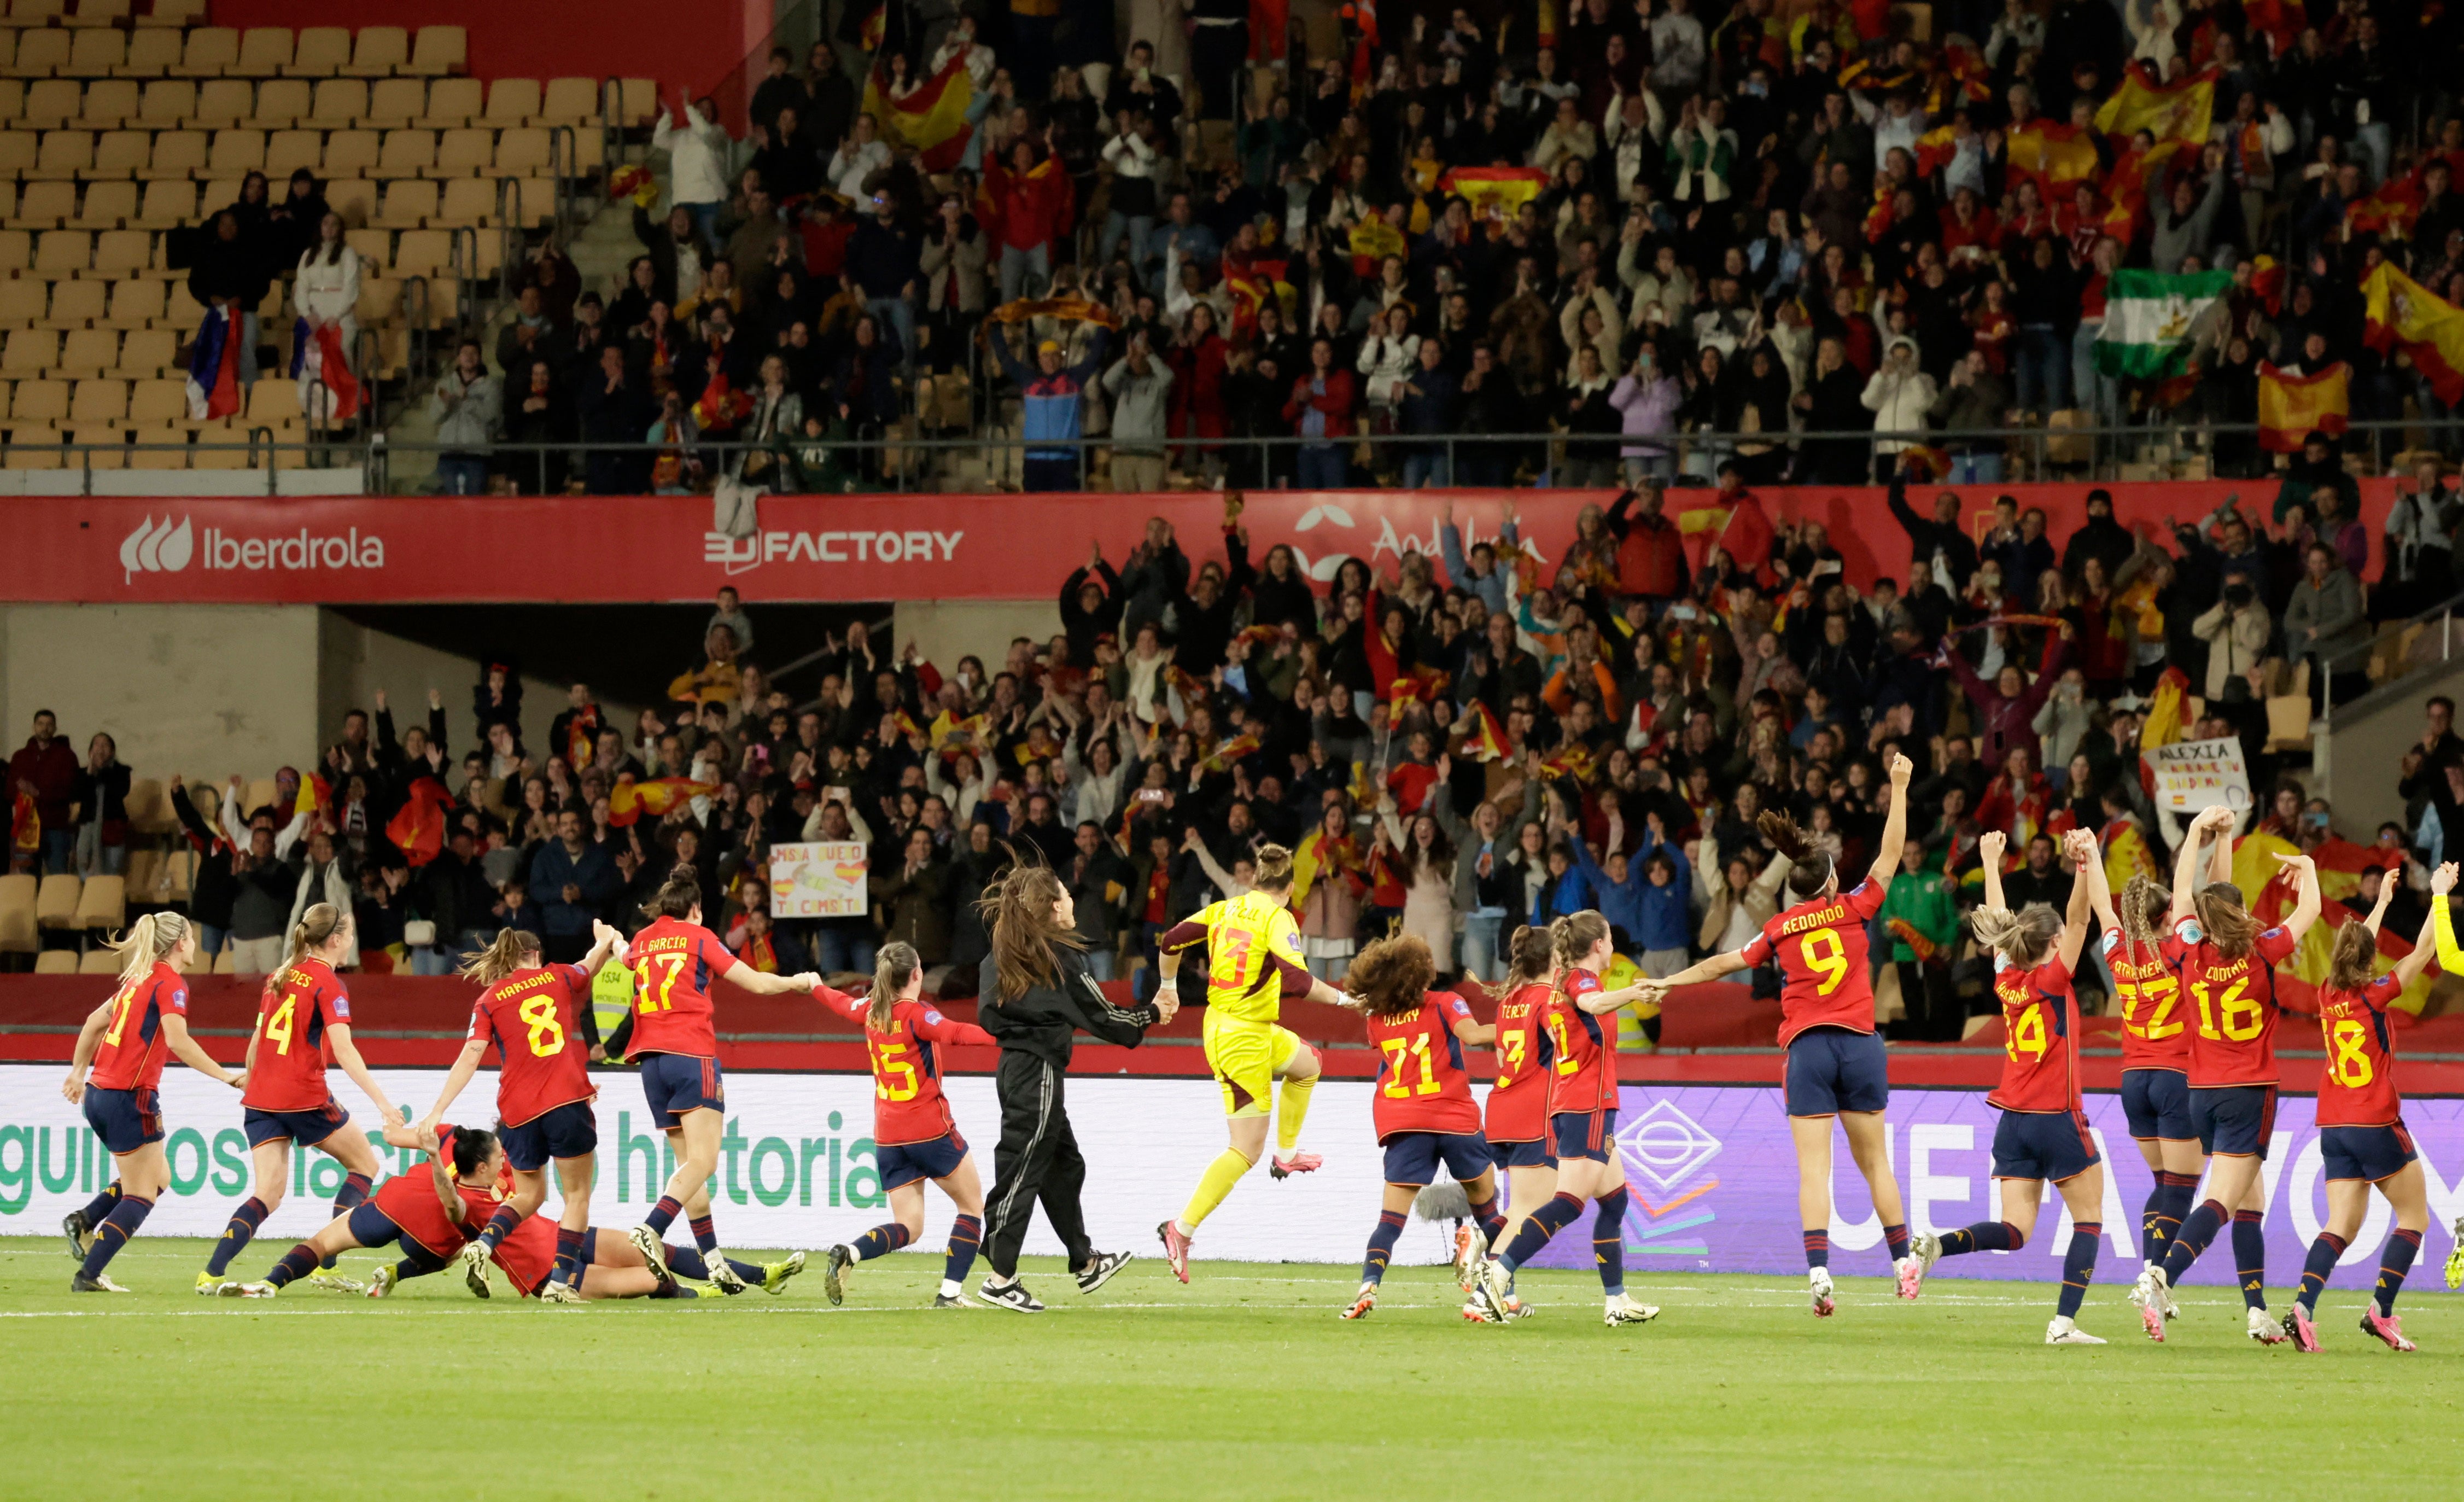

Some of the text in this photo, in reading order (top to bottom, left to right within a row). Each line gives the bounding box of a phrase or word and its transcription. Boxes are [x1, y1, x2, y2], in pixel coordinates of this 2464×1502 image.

[204, 527, 385, 570] Iberdrola
[2159, 743, 2228, 760] ALEXIA
[648, 935, 688, 952] GARCÍA
[1782, 904, 1845, 935] REDONDO
[495, 971, 556, 1002] MARIONA
[602, 971, 621, 984] 1534
[635, 952, 688, 1014] 17
[1208, 924, 1252, 990] 13
[1800, 927, 1848, 996] 9
[2205, 958, 2249, 982] CODINA
[266, 993, 296, 1056] 4
[519, 994, 565, 1058] 8
[2002, 1002, 2047, 1063] 14
[2115, 975, 2185, 1040] 22
[2189, 976, 2264, 1041] 16
[2324, 1001, 2354, 1018] ROZ
[867, 1038, 919, 1102] 15
[1380, 1032, 1441, 1099] 21
[1497, 1029, 1526, 1089] 3
[2321, 1018, 2373, 1088] 18
[618, 1110, 887, 1208] hitoria
[1698, 1260, 1709, 1268] TM
